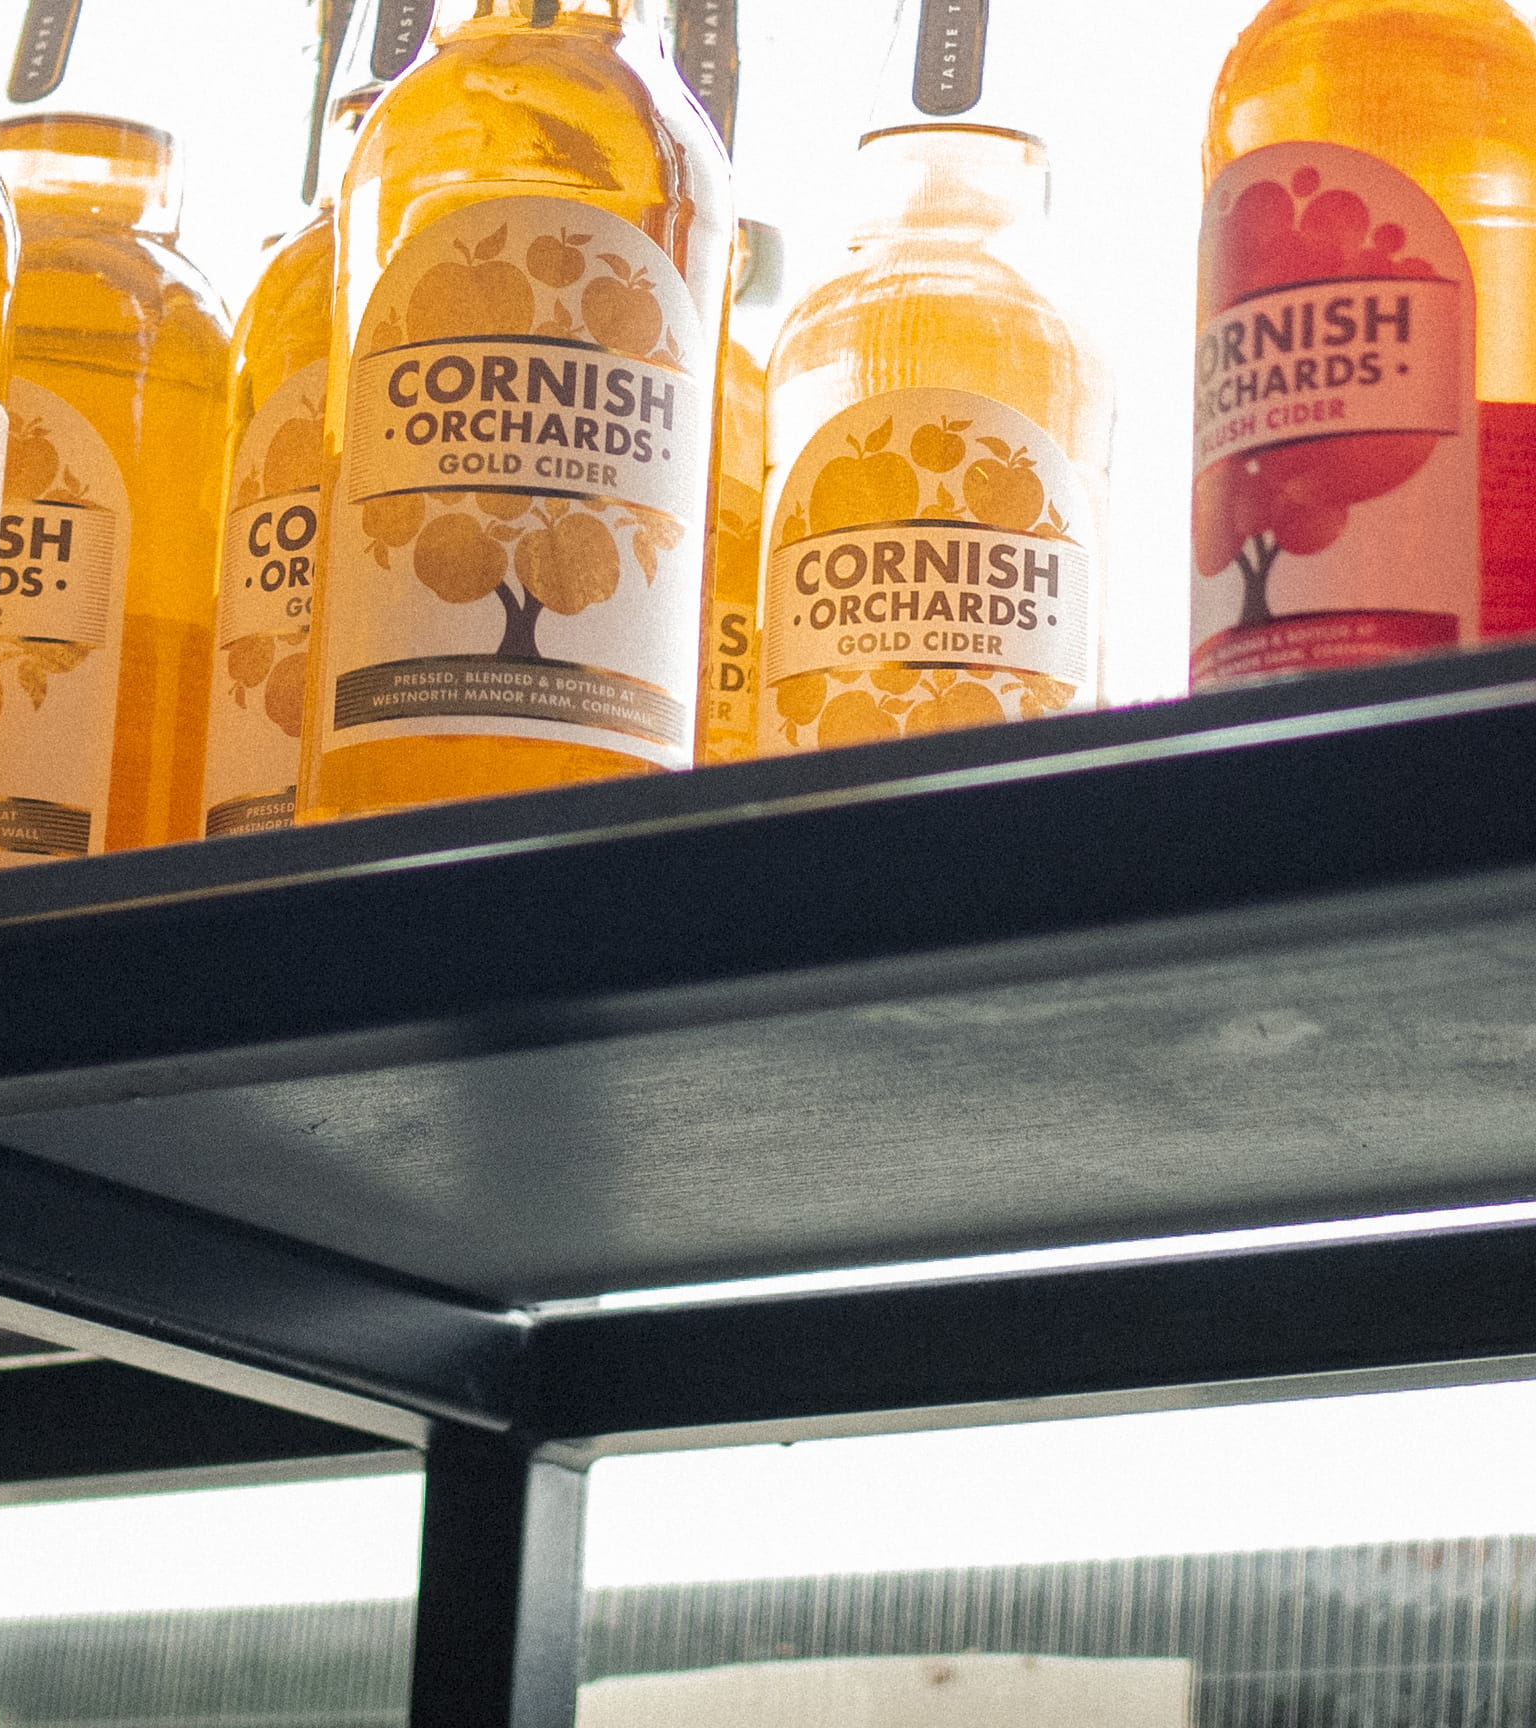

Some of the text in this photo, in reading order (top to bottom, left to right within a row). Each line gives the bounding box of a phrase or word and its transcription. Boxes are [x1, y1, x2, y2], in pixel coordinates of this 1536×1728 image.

[940, 28, 960, 92] TASTE
[699, 61, 716, 97] THE
[388, 355, 675, 431] CORNISH
[1267, 398, 1346, 429] CIDER
[405, 409, 654, 464] ORCHARDS
[438, 453, 618, 488] GOLD CIDER
[796, 539, 1059, 598] CORNISH
[810, 590, 1038, 631] ORCHARDS
[837, 631, 1003, 656] GOLD CIDER
[372, 690, 458, 707] WESTNORTH
[464, 689, 524, 703] MANOR
[465, 672, 533, 687] BLENDED
[556, 678, 616, 697] BOTTLED
[619, 690, 635, 704] AT
